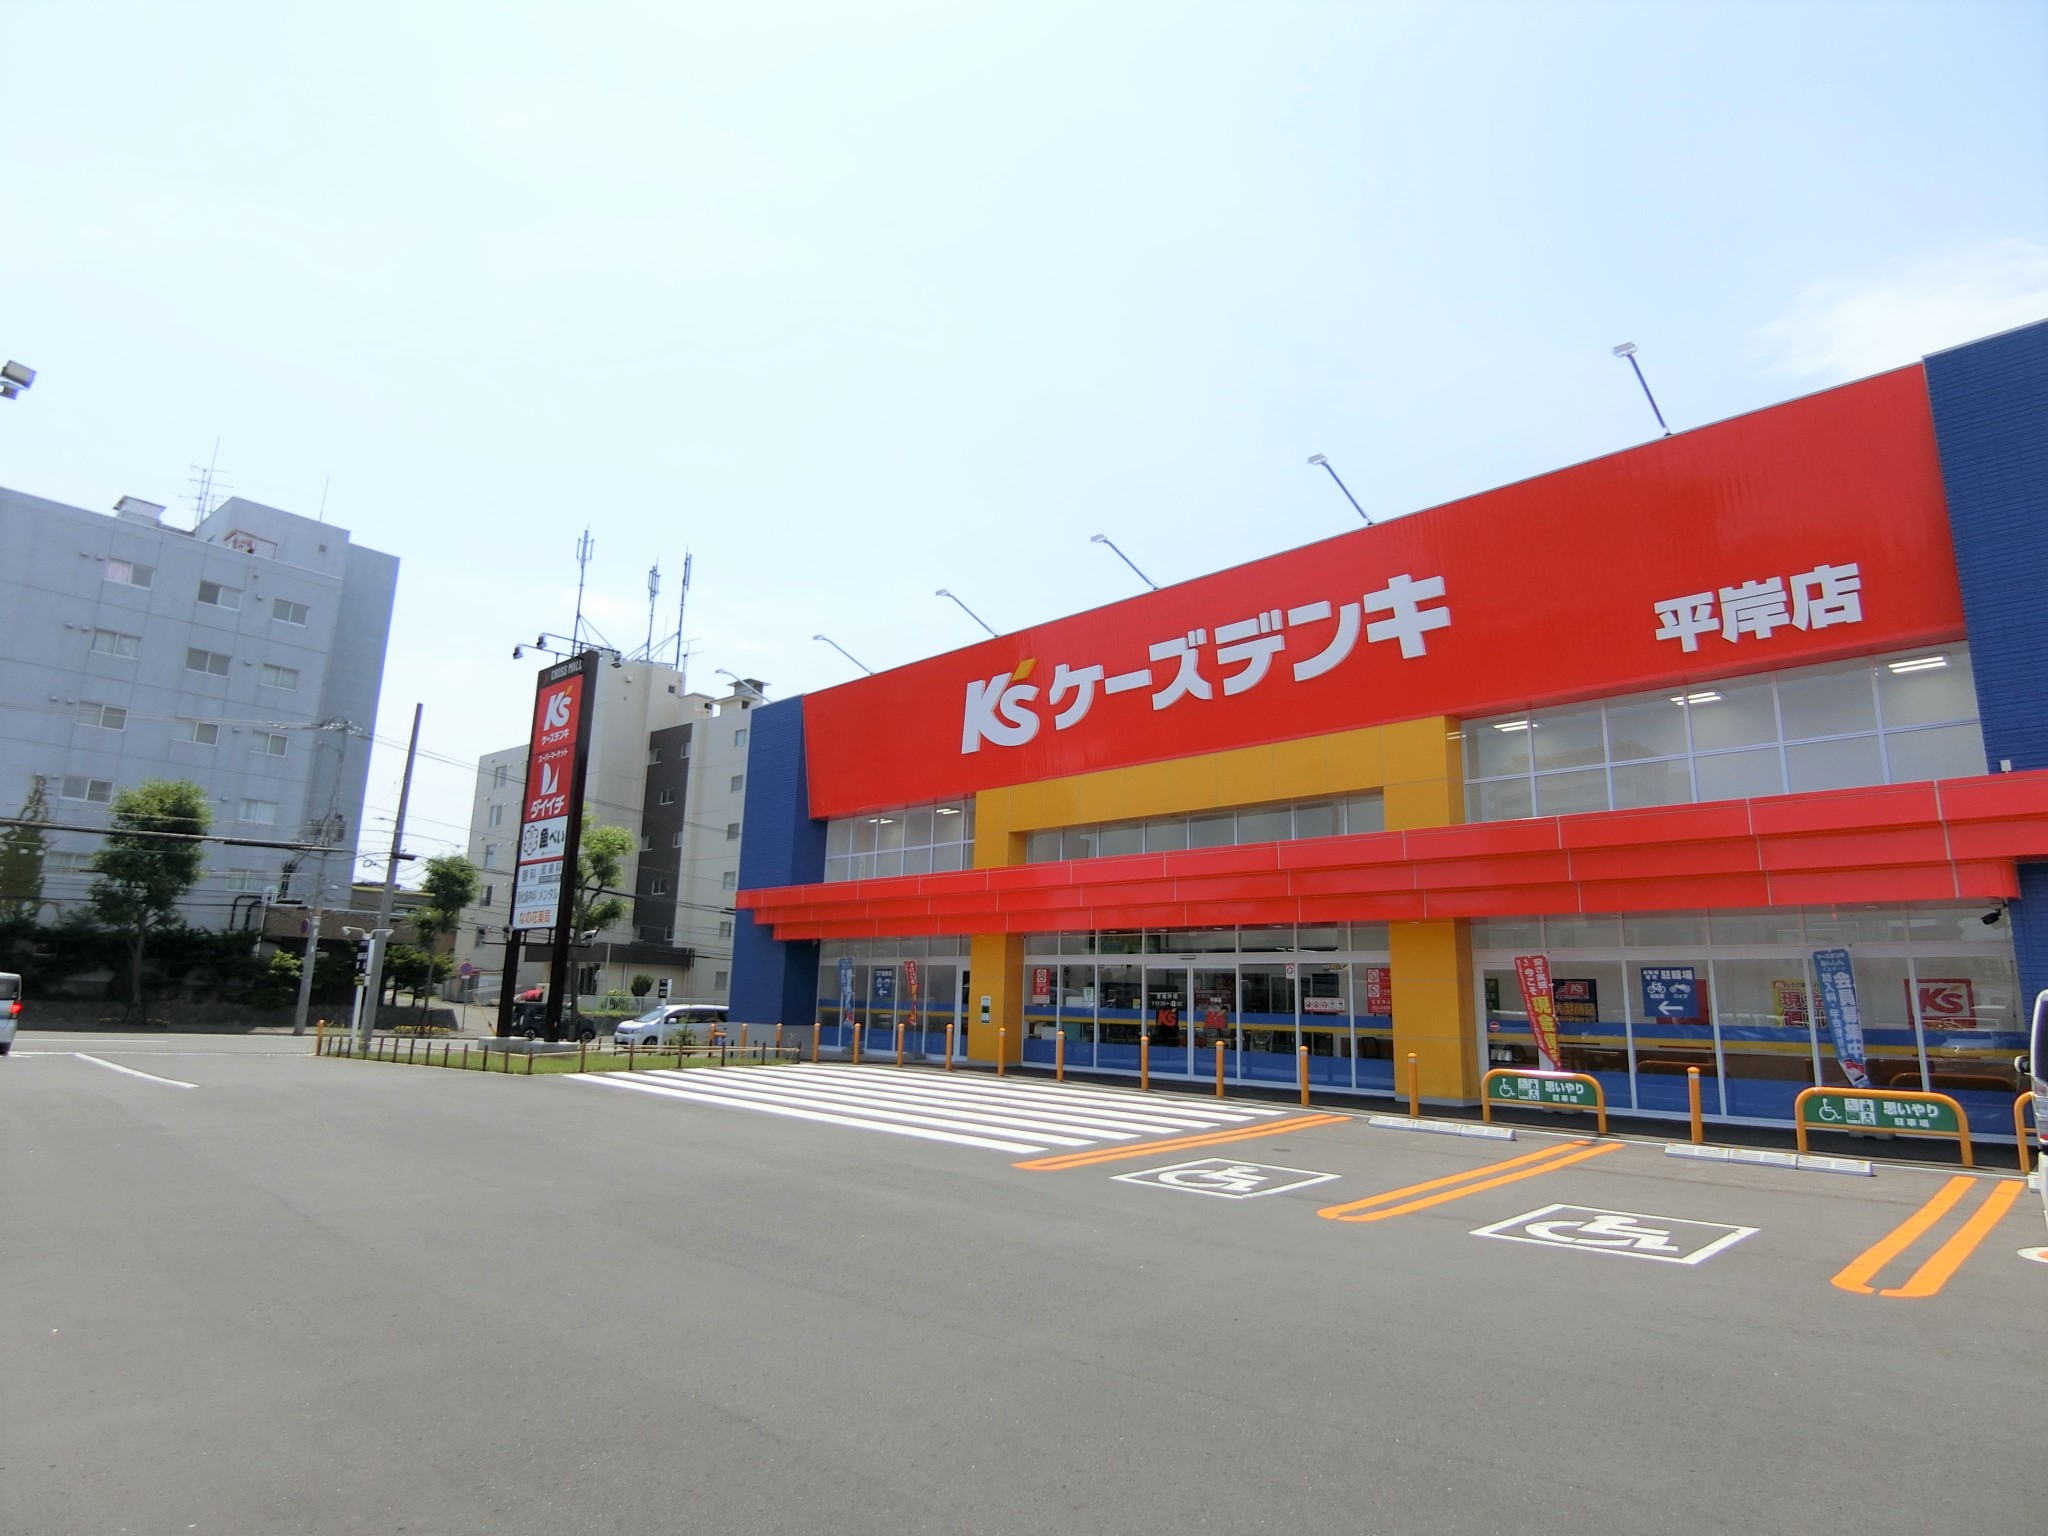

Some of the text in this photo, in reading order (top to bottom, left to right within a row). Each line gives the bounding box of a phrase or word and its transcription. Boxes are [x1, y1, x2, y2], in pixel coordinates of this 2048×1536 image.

[1654, 562, 1862, 653] 平岸店
[1050, 573, 1451, 730] ケーズデンキ
[551, 659, 583, 681] CROSS MALL
[541, 729, 570, 746] ケーズデンキ
[538, 749, 569, 763] スーパーマーケット
[531, 794, 565, 819] ダイイチ
[540, 828, 565, 848] 魚べい
[539, 888, 558, 901] メンタル
[519, 910, 551, 924] なの花薬局
[1833, 971, 1861, 1059] 会員募集中
[1545, 1080, 1584, 1095] 思いやり
[1552, 1094, 1578, 1103] 駐車場
[1883, 1101, 1939, 1117] 思いやり
[1894, 1117, 1930, 1128] 駐車場
